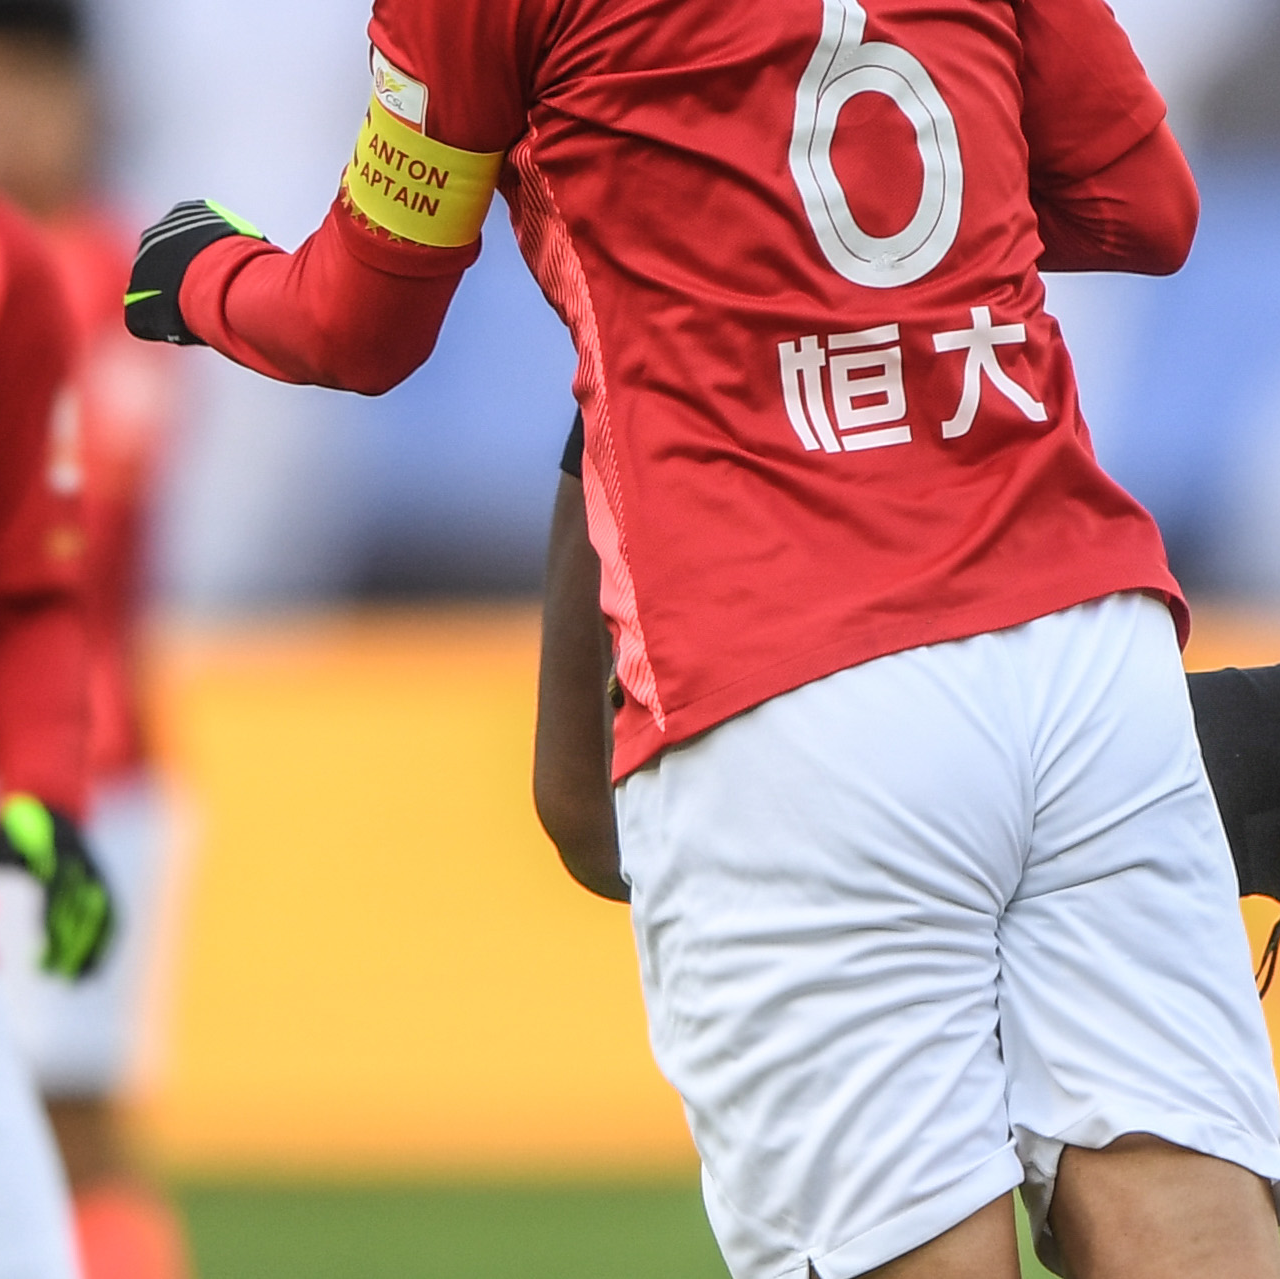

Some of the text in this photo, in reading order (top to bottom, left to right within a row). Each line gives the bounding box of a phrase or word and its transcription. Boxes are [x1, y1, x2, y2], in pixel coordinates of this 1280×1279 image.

[385, 94, 404, 111] CSL
[354, 144, 440, 217] APTAIN
[366, 106, 449, 190] ANTON
[777, 306, 1048, 454] 恒大
